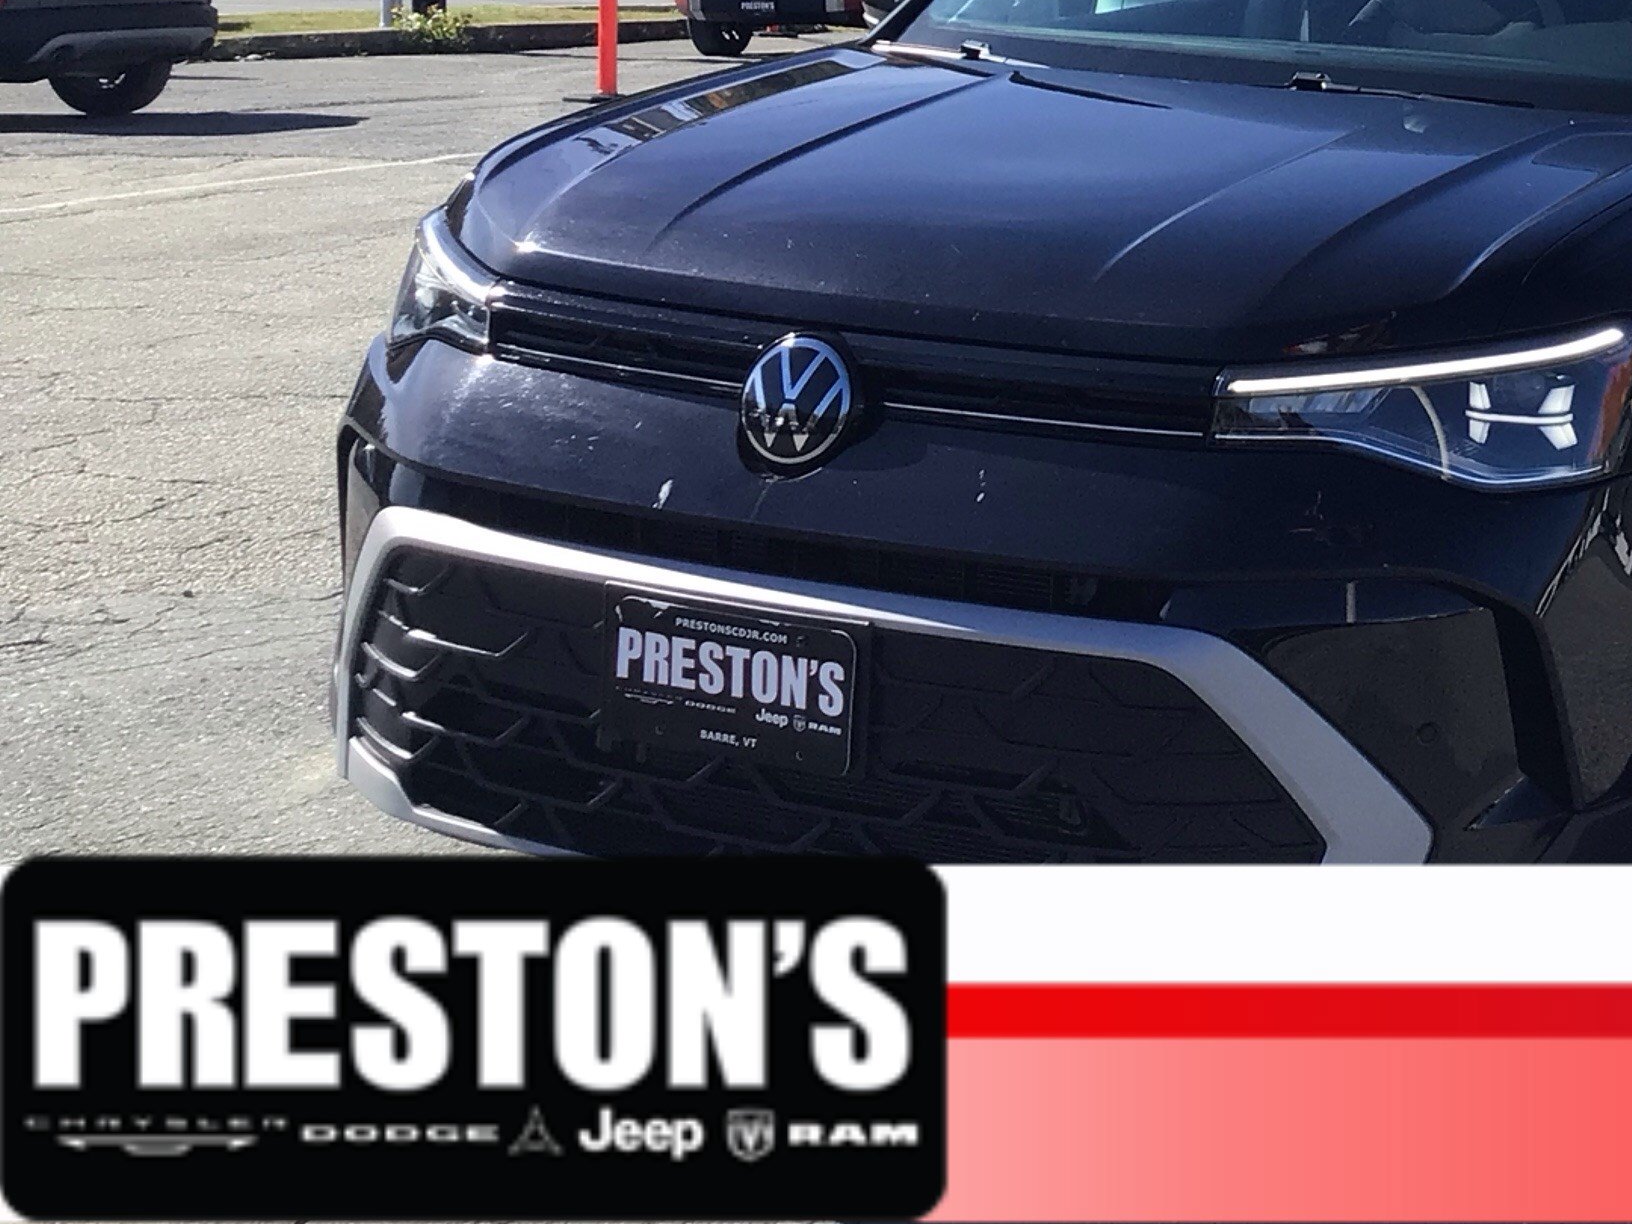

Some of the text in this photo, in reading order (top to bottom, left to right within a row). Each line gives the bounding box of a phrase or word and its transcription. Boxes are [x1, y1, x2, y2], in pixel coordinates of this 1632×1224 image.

[675, 616, 789, 645] PRESTONSCDJR.COM
[616, 626, 846, 717] PRESTON'S
[755, 708, 789, 728] Jeep
[700, 729, 757, 748] BARRE, VT
